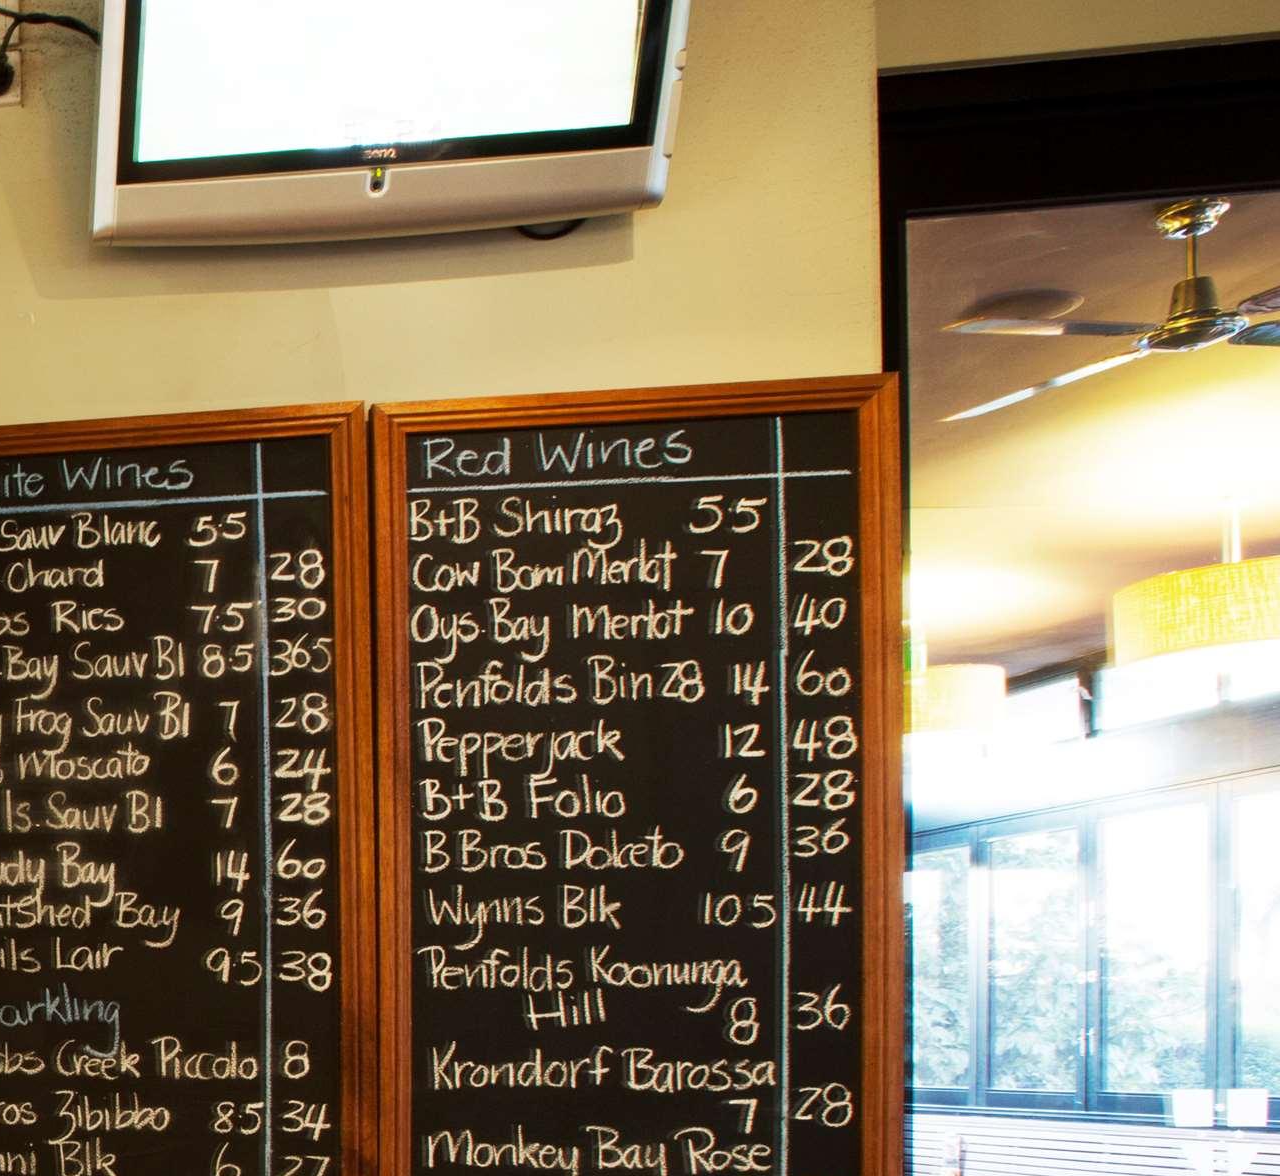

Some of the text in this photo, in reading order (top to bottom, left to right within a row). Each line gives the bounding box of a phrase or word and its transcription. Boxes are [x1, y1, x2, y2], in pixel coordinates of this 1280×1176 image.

[63, 457, 195, 490] Wines
[422, 429, 693, 479] Red Wines
[70, 512, 162, 549] Blanc
[410, 498, 481, 544] B+B
[494, 496, 622, 548] Shiraz
[7, 559, 104, 593] Chard
[194, 560, 220, 592] 7
[269, 549, 326, 589] 28
[412, 553, 480, 592] Cow
[571, 540, 677, 590] Merlot
[700, 549, 730, 589] 7
[793, 536, 855, 576] 28
[271, 599, 327, 622] 30
[489, 598, 550, 662] Bay
[572, 600, 694, 641] Merlot
[713, 599, 754, 636] 10
[793, 593, 846, 634] 40
[1, 644, 59, 700] Bay
[72, 641, 147, 680] Sauv
[417, 649, 851, 709] Penfolds Bin 28 14 60
[15, 698, 71, 753] Frog
[81, 697, 149, 737] Sauv
[218, 701, 239, 741] 7
[274, 693, 329, 734] 28
[417, 715, 857, 778] Pepperjack 12 48
[18, 743, 150, 780] Moscato
[213, 747, 239, 786] 6
[273, 748, 331, 792] 24
[44, 790, 116, 833] Sauv
[212, 798, 238, 829] 7
[277, 792, 331, 825] 28
[419, 770, 855, 822] B+B Folio 6 28
[57, 842, 116, 906] Bay
[216, 851, 250, 893] 14
[275, 838, 327, 879] 60
[721, 830, 751, 872] 9
[792, 821, 851, 858] 36
[115, 892, 181, 947] Bay
[221, 898, 244, 936] 9
[276, 889, 327, 929] 36
[428, 884, 545, 950] Wynns
[562, 884, 623, 930] Blk
[796, 880, 853, 927] 44
[56, 937, 124, 972] Lair
[278, 950, 332, 992] 38
[417, 945, 749, 1014] Penfolds Koonunga
[526, 984, 851, 1046] Hill 8 36
[57, 1039, 142, 1080] Creek
[150, 1036, 259, 1081] Piccolo
[284, 1040, 310, 1078] 8
[432, 1041, 777, 1092] Krondorf Barossa
[55, 1089, 171, 1140] Zibibbo
[281, 1099, 331, 1141] 34
[729, 1083, 853, 1134] 7 28
[673, 1126, 773, 1174] Rose
